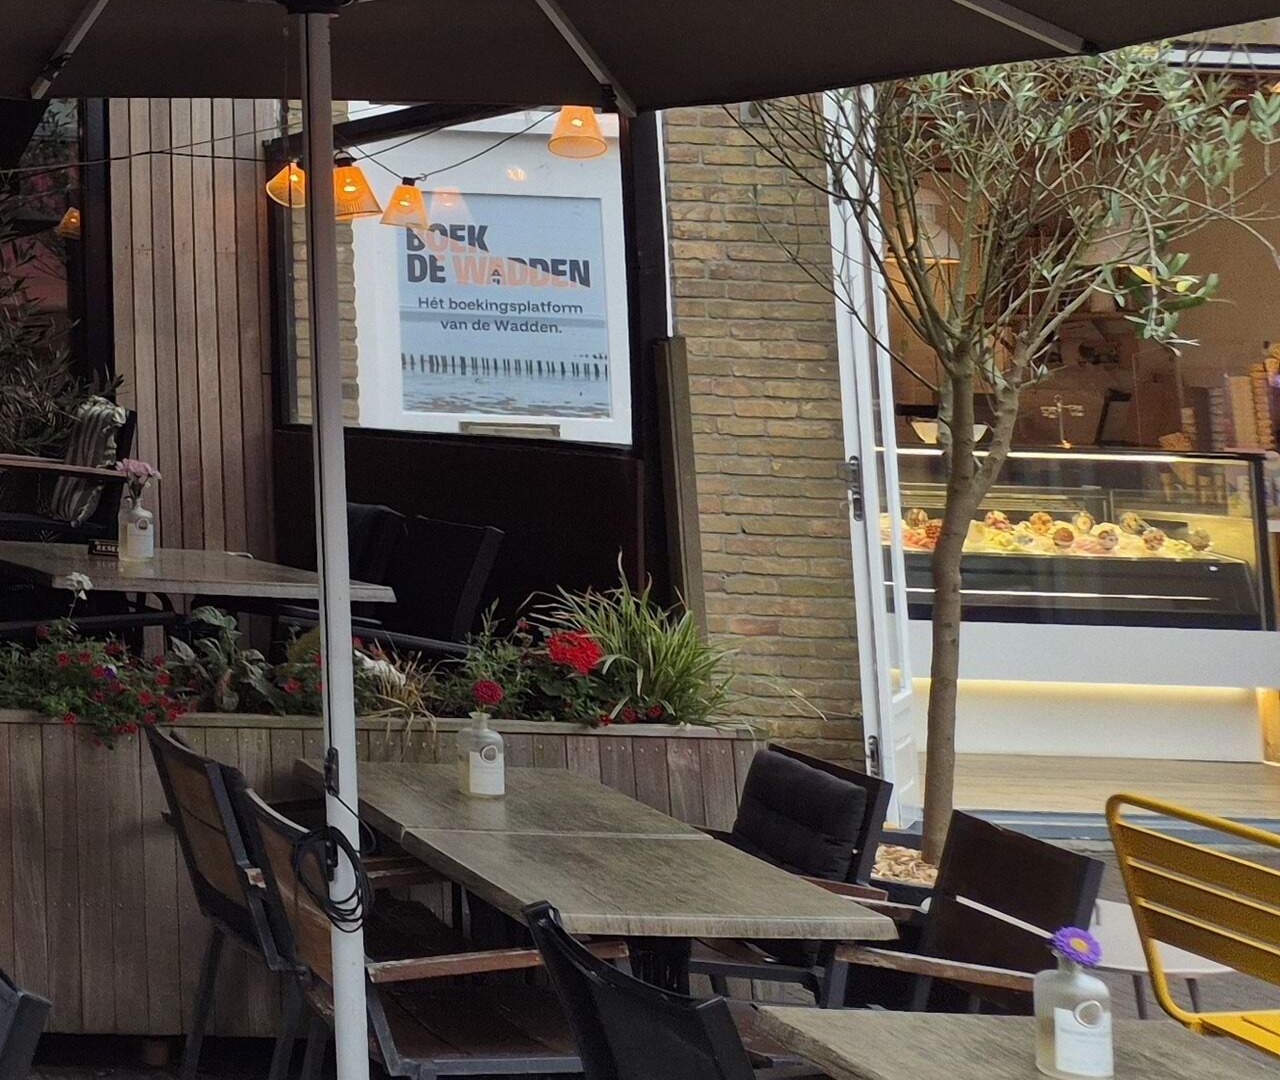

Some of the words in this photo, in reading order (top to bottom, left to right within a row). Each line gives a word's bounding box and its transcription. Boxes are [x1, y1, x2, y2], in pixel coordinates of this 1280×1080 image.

[406, 223, 489, 253] BOEK
[407, 253, 447, 284] DE
[452, 255, 591, 289] WADDEN
[418, 296, 444, 310] Hét
[449, 298, 583, 315] boekingsplatform
[441, 321, 467, 331] van
[472, 319, 490, 332] de
[494, 320, 563, 335] Wadden.
